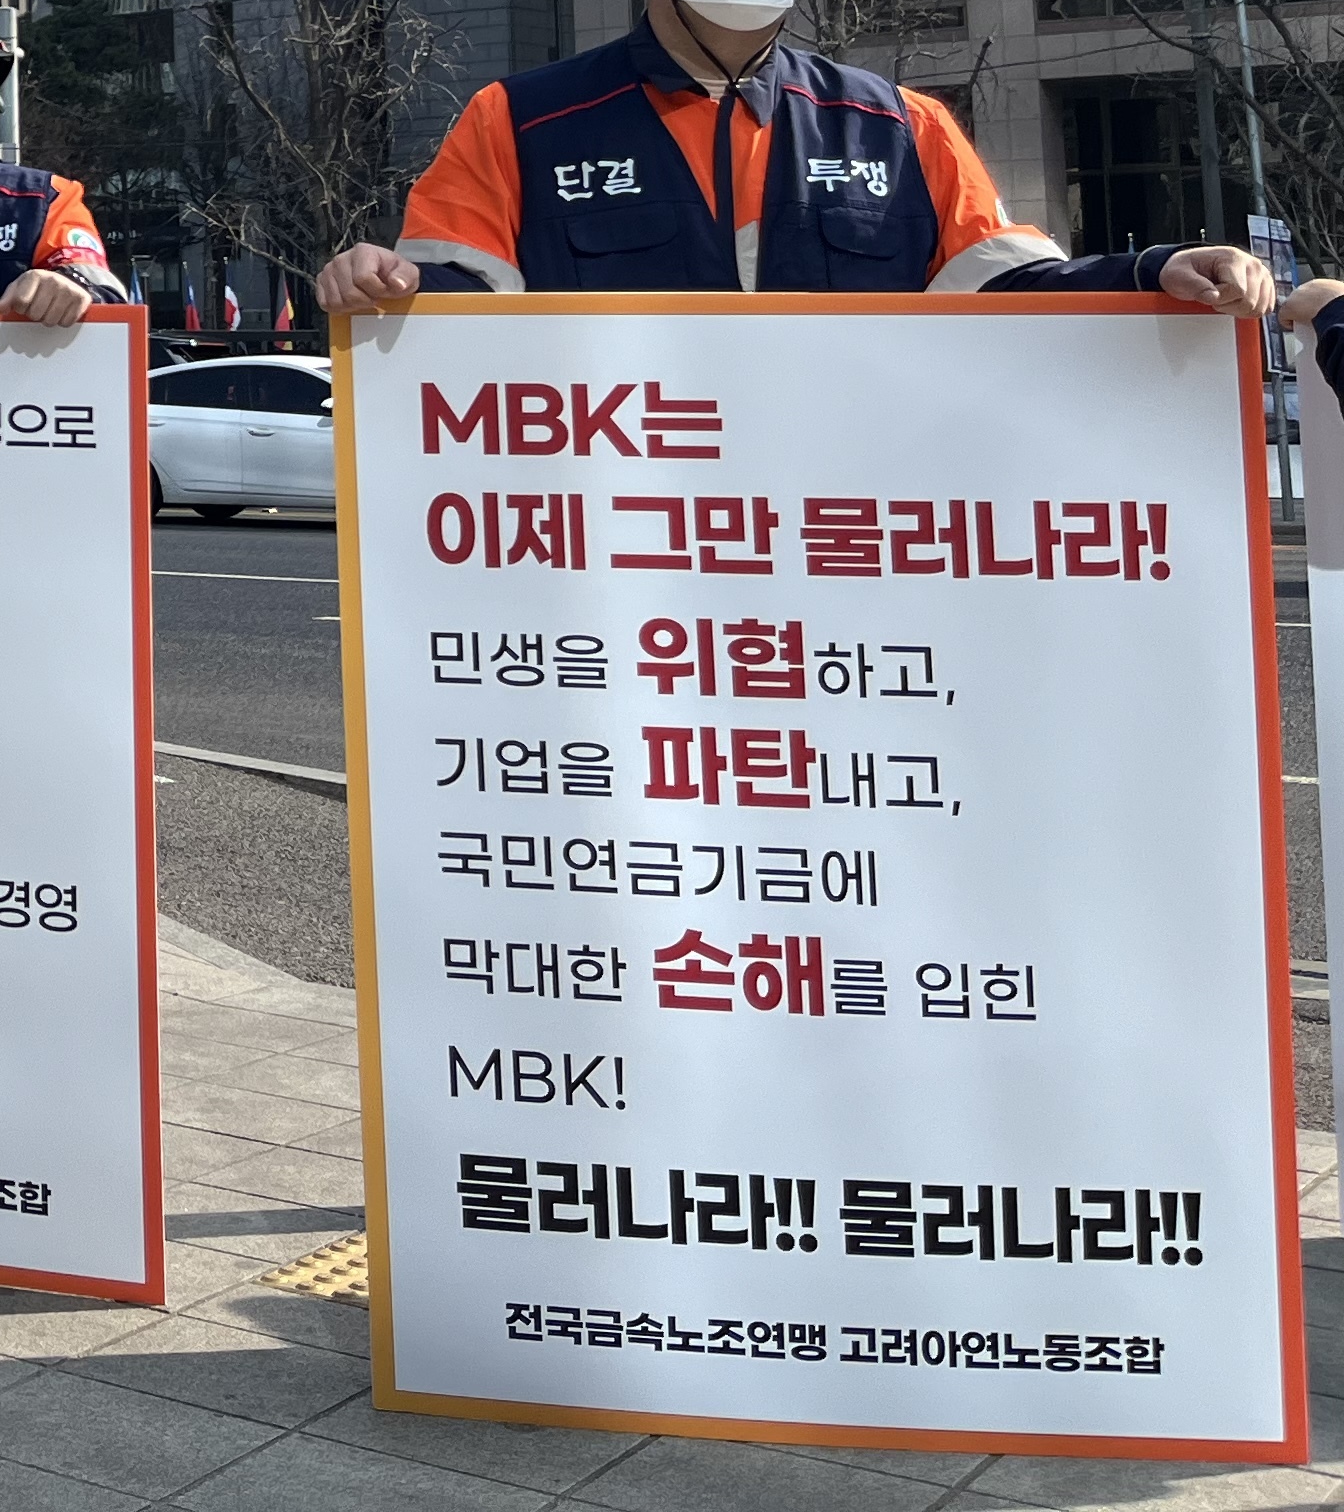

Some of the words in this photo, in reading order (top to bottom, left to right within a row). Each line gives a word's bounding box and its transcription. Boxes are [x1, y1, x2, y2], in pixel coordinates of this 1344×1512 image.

[552, 158, 642, 201] 단결
[804, 156, 890, 198] 투쟁
[421, 381, 723, 460] MBK는
[426, 491, 587, 572] 이제
[609, 495, 781, 576] 그만
[799, 497, 1172, 582] 물러나라!
[428, 630, 610, 690] 민생을
[635, 616, 957, 707] 위협하고,
[434, 737, 615, 798] 기업을
[640, 725, 962, 817] 파탄내고,
[436, 830, 879, 907] 국민연금기금에
[442, 936, 627, 1003] 막대한
[651, 928, 889, 1018] 손해를
[914, 962, 1038, 1022] 입힌
[447, 1045, 628, 1112] MBK!
[456, 1151, 819, 1254] 물러나라!!
[838, 1177, 1204, 1267] 물러나라!!
[504, 1301, 828, 1362] 전국금속노조연맹
[838, 1326, 1165, 1376] 고려아연노동조합
